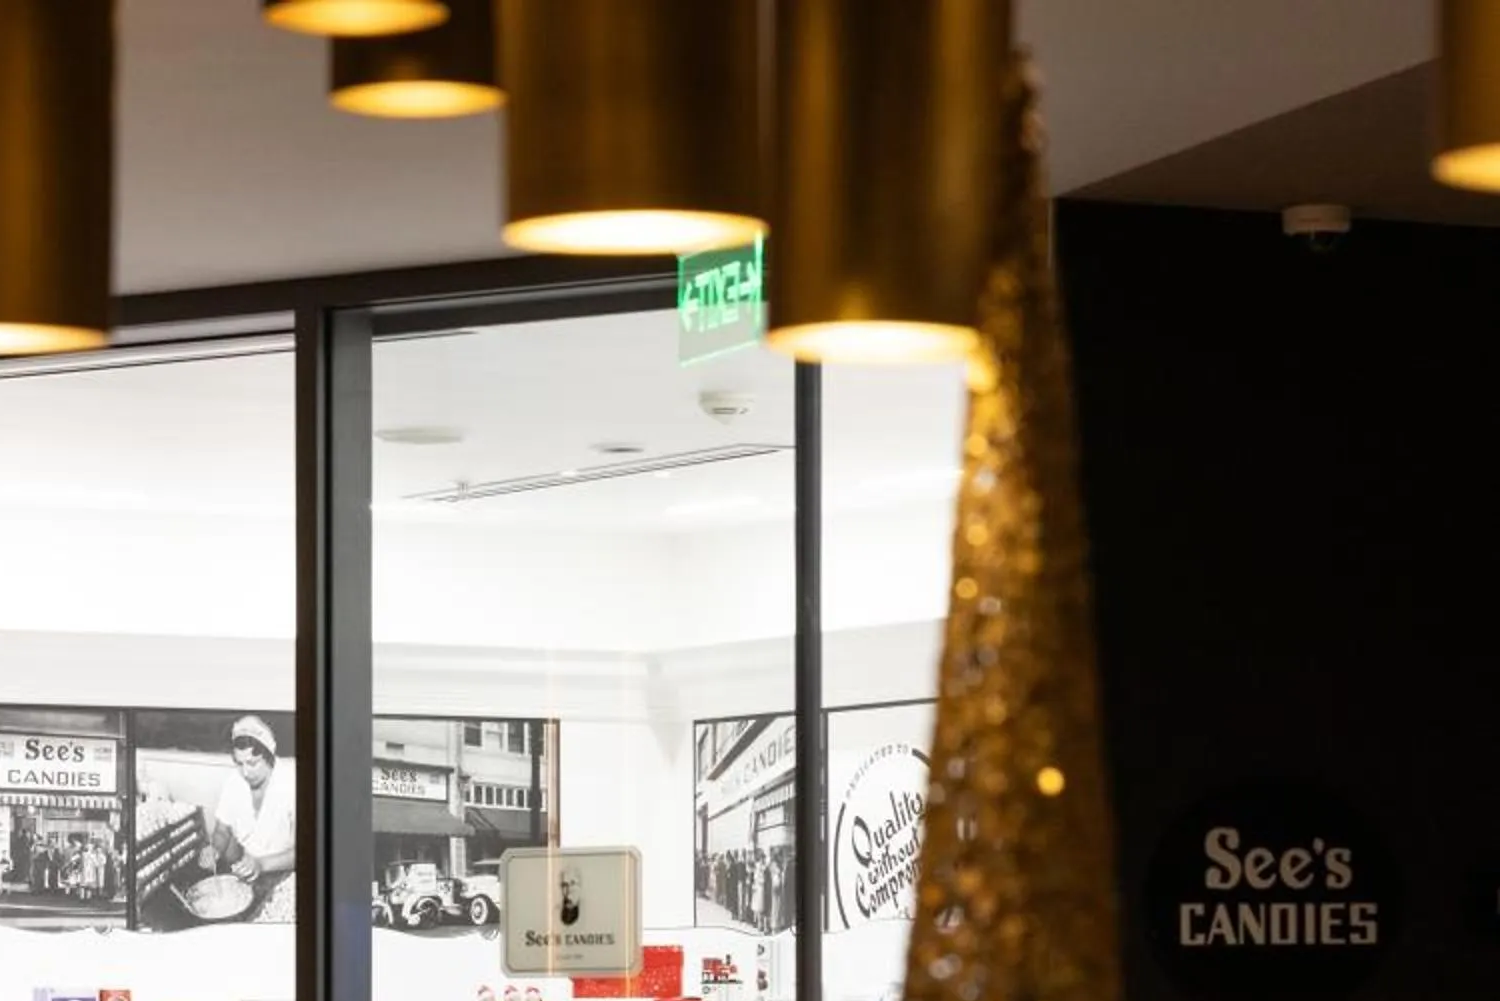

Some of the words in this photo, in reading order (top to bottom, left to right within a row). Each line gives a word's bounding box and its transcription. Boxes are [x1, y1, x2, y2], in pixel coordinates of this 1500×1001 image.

[25, 738, 85, 763] See's
[7, 769, 101, 787] CANDIES
[1204, 826, 1353, 890] See's
[1179, 903, 1378, 946] CANDIES
